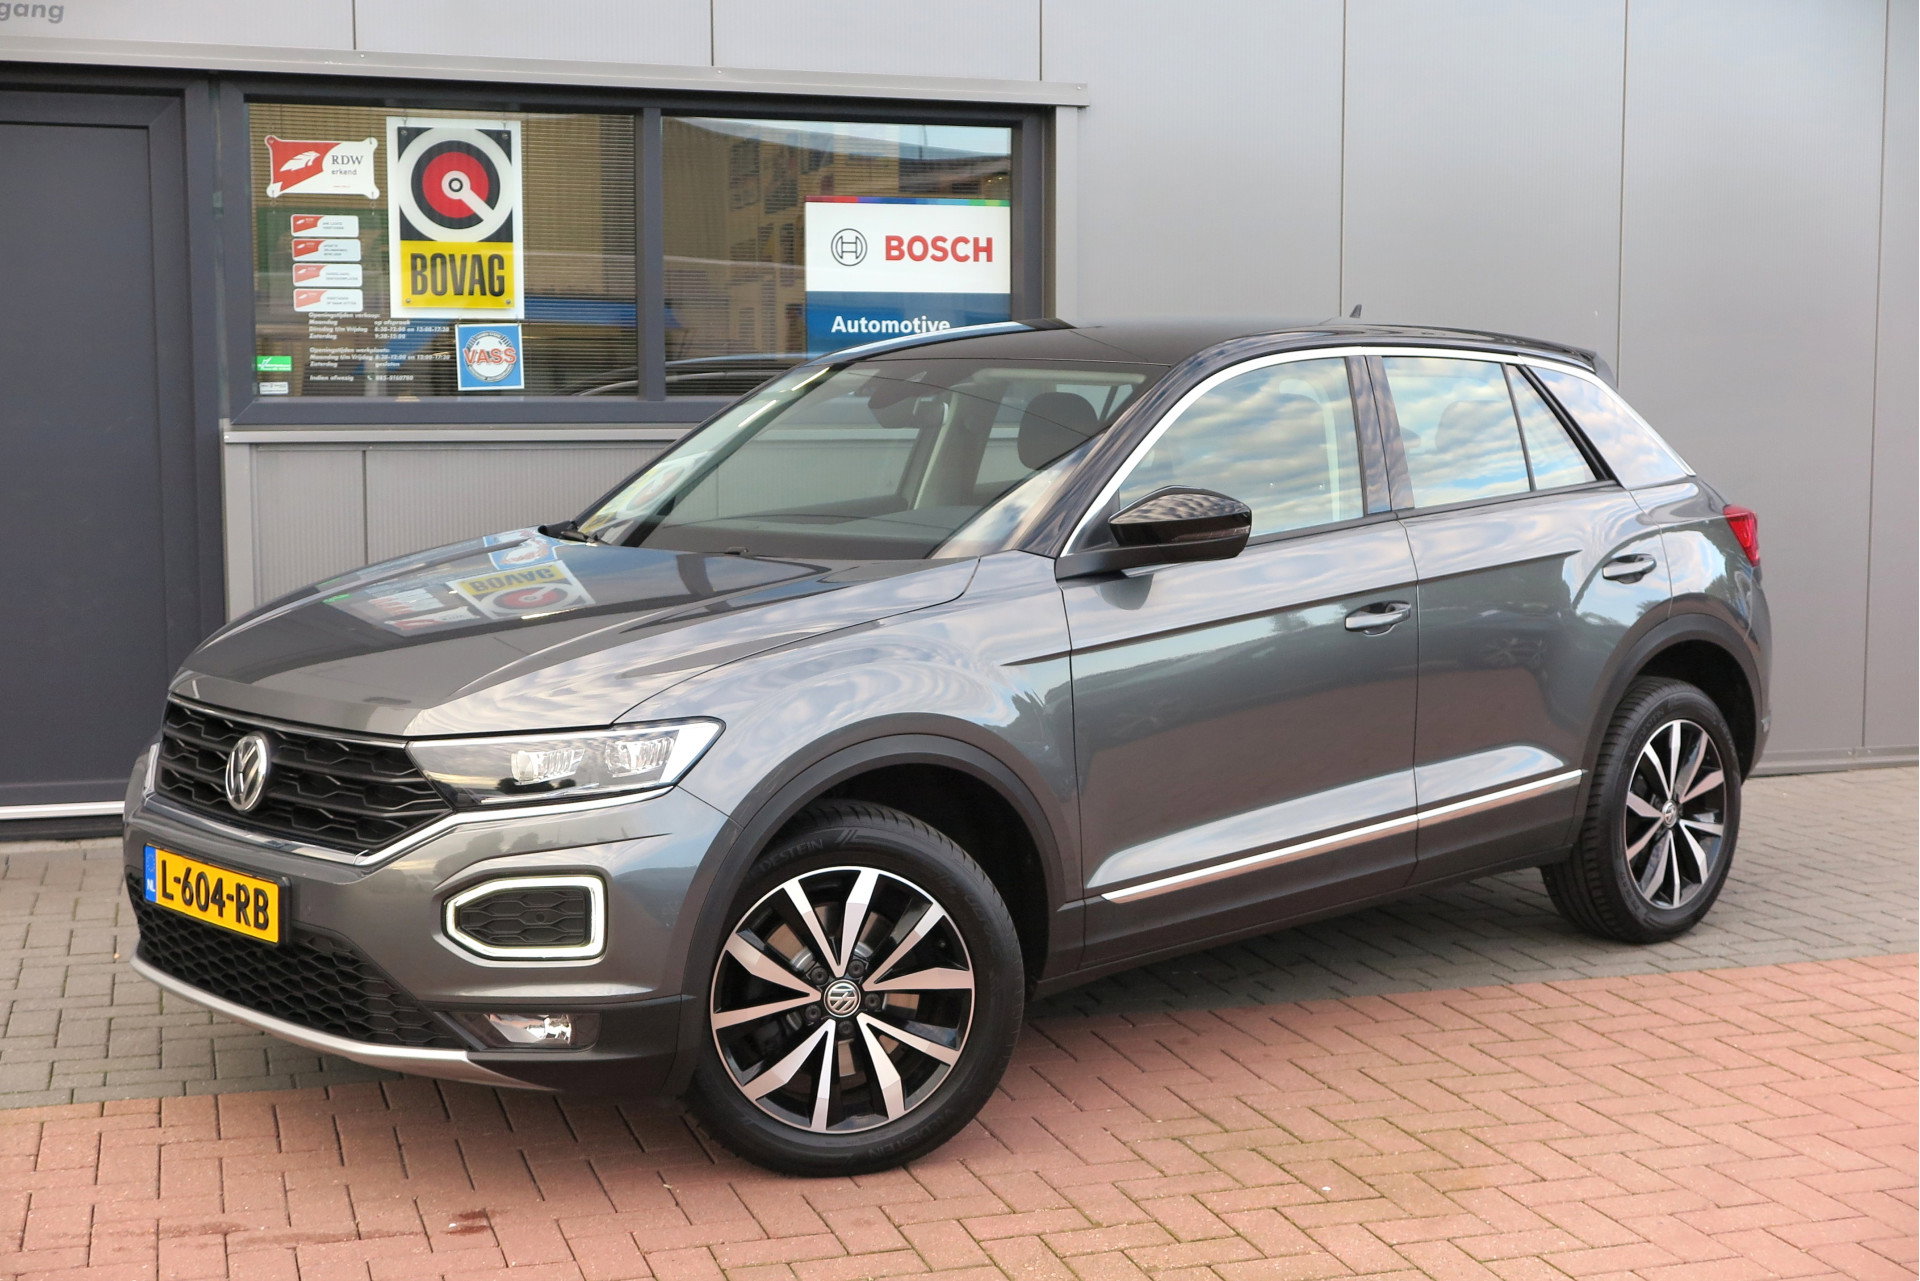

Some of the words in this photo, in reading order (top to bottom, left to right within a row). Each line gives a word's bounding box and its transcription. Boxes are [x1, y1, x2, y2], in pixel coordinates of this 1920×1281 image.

[0, 2, 64, 24] gang
[331, 154, 364, 165] RDW
[885, 235, 994, 263] BOSCH
[410, 252, 505, 297] BOVAG
[831, 315, 951, 334] Automotive
[463, 348, 517, 365] VASS
[146, 878, 156, 893] NL
[161, 859, 269, 931] L-604-RB
